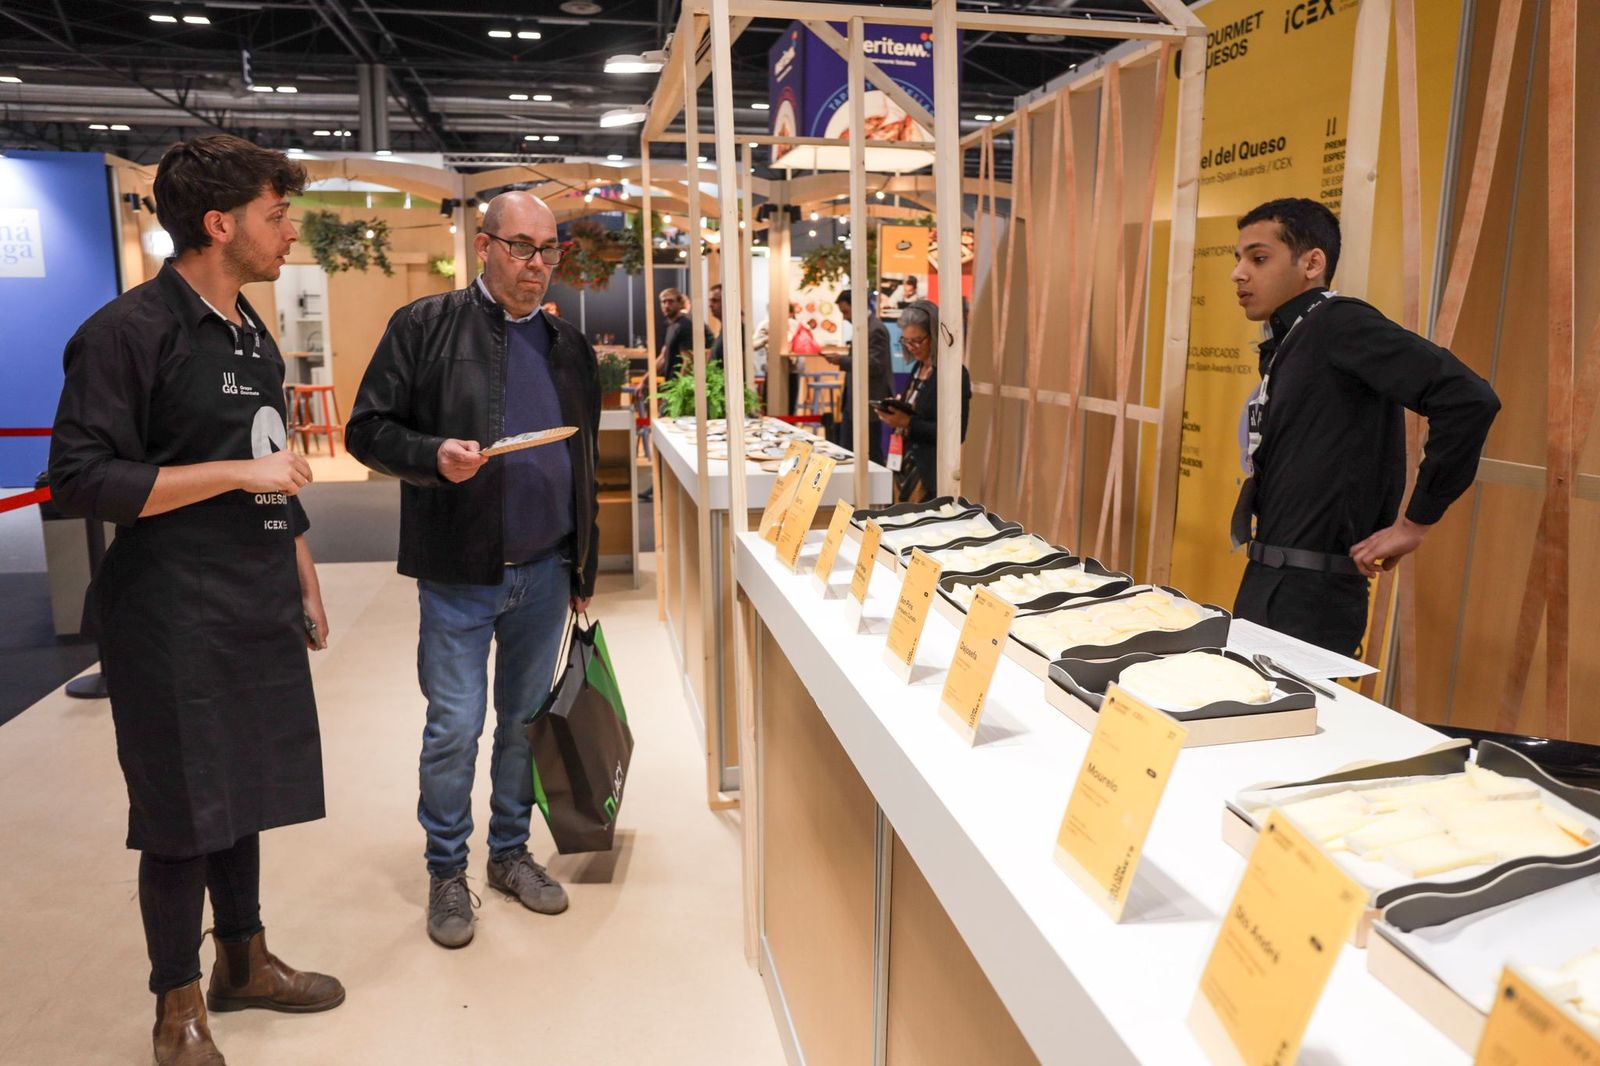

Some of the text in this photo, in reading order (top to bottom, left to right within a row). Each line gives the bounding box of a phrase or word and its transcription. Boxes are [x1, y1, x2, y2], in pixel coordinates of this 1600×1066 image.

[1206, 11, 1264, 50] OURMET
[1206, 38, 1249, 71] UESOS
[1201, 136, 1286, 169] el del Queso
[1323, 151, 1346, 163] ESPEC
[1320, 187, 1342, 199] CHEES
[0, 243, 33, 265] ga
